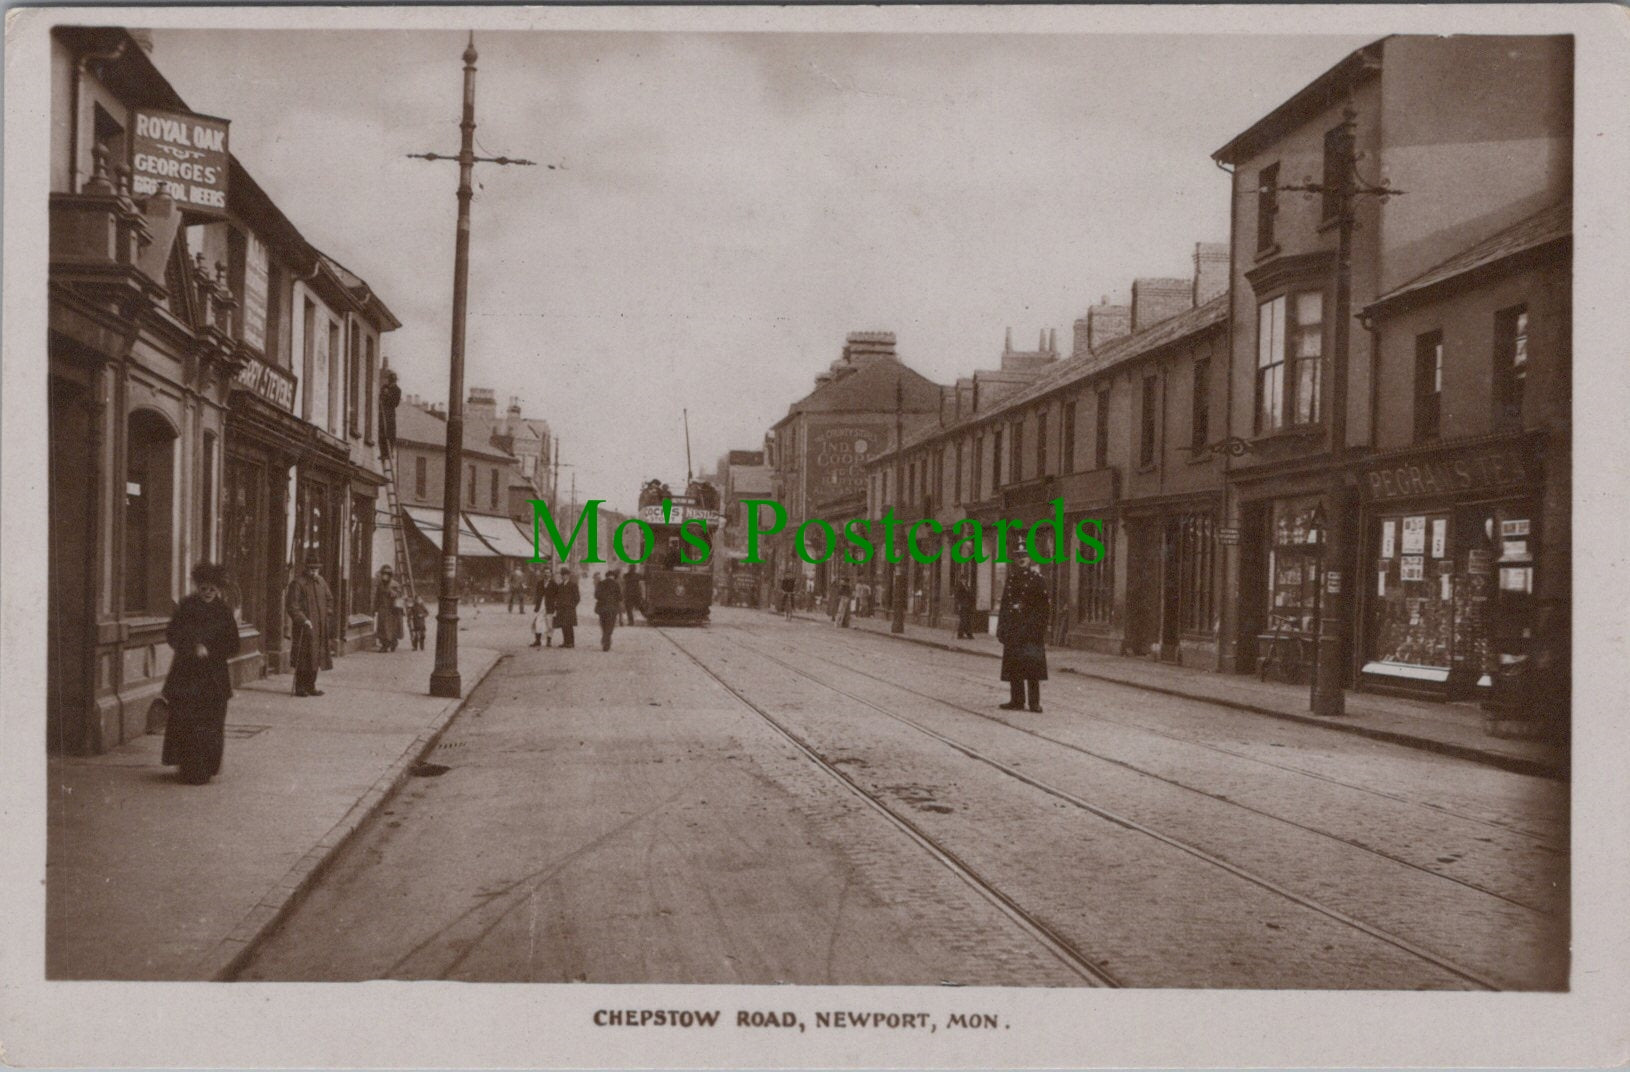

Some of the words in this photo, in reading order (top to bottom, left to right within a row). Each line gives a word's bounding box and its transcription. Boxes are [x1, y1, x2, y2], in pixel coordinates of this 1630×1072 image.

[136, 113, 192, 147] ROYAL
[193, 125, 225, 153] OAK
[190, 185, 226, 208] BEERS
